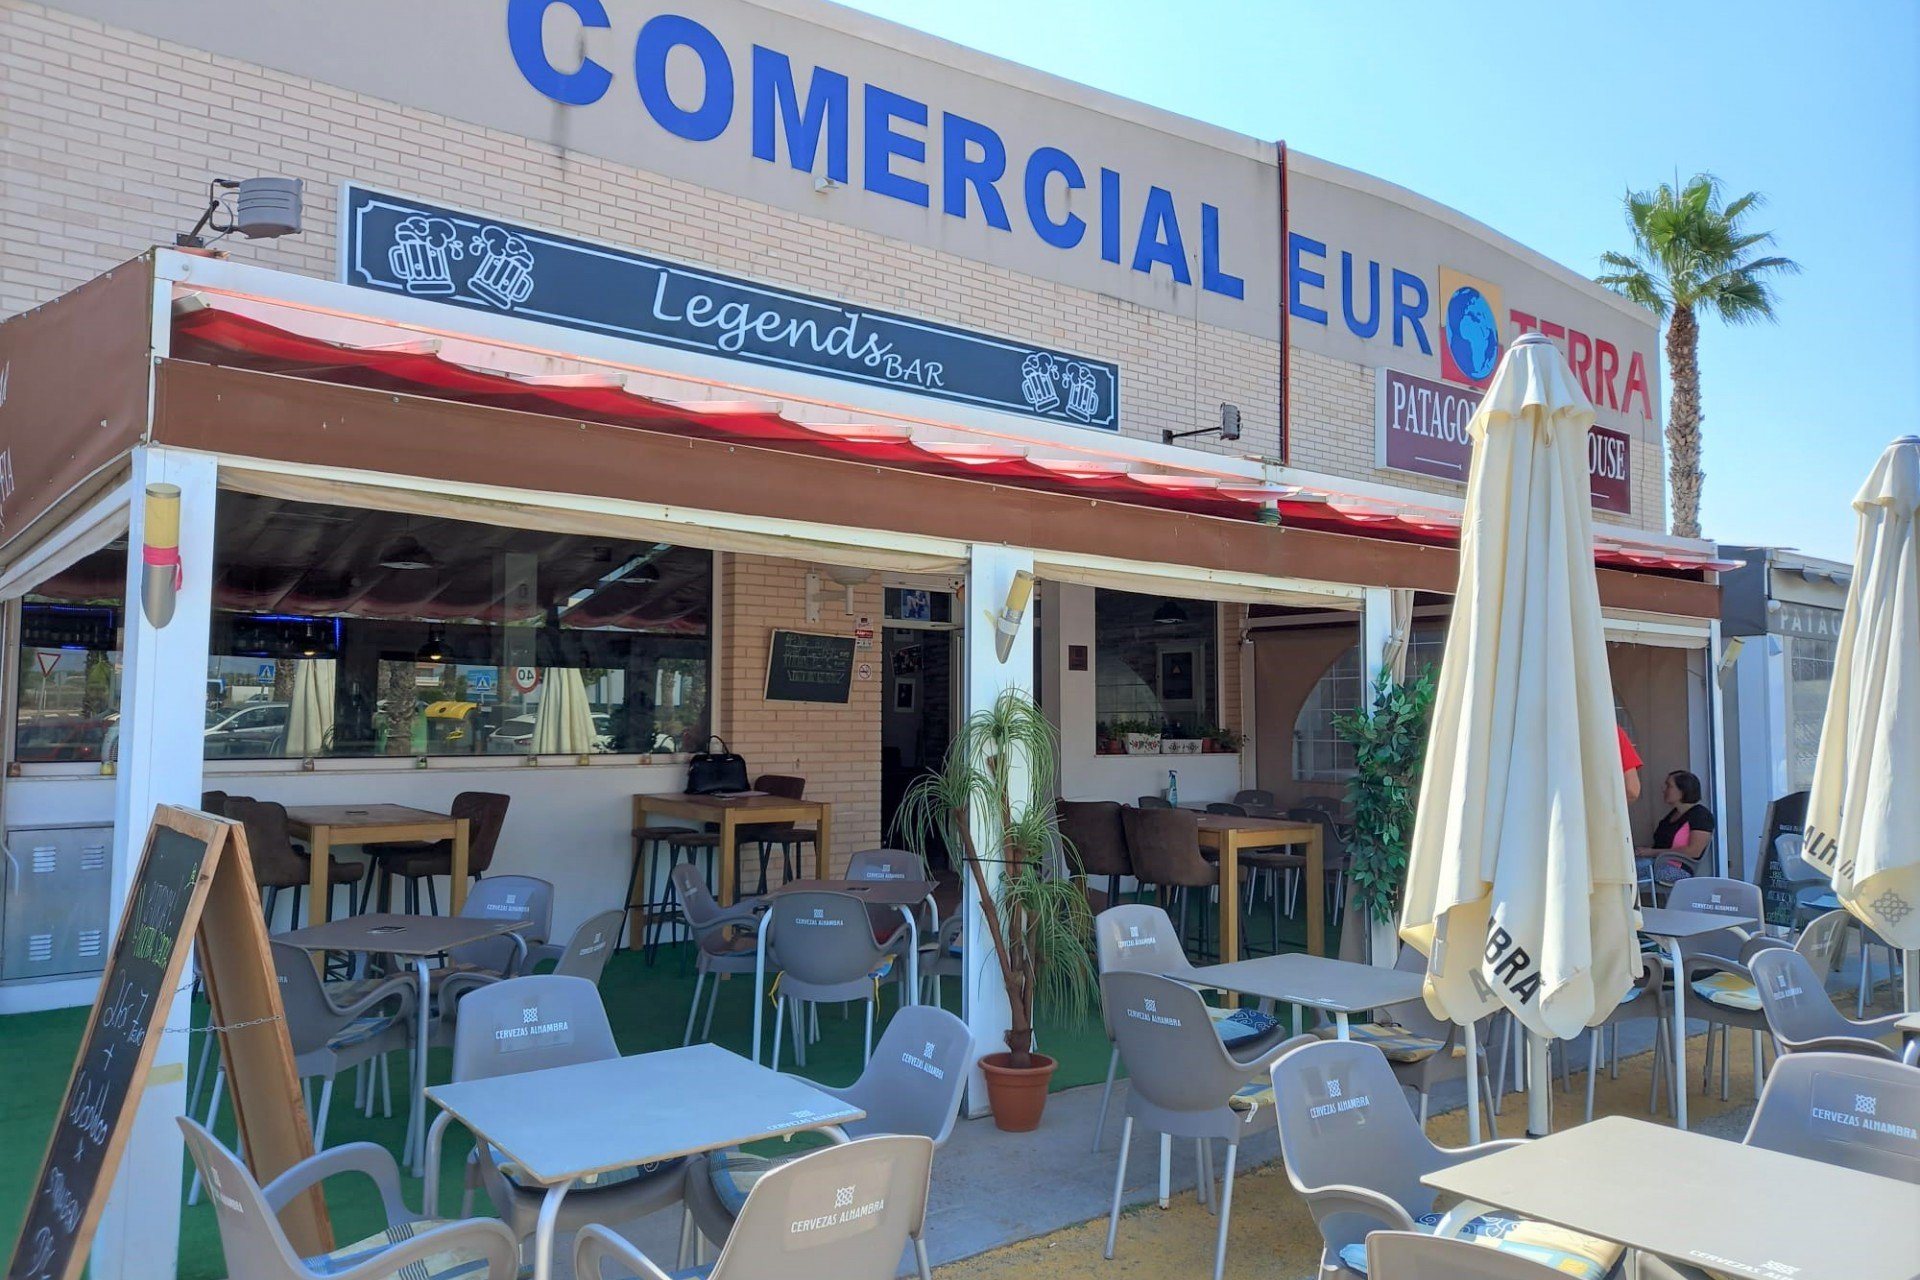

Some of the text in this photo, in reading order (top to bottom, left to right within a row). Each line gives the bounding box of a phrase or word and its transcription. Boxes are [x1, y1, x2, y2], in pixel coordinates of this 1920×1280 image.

[508, 0, 1244, 300] COMERCIAL
[1509, 308, 1652, 420] TRRA
[652, 271, 945, 387] Legends BAR
[495, 1021, 569, 1040] CERVEZAS ALHAMBRA
[1309, 1095, 1371, 1119] CERVEZAS ALHAMBRA
[1812, 1107, 1918, 1140] CERVEZAS ALHAMBRA
[790, 1199, 885, 1233] CERVEZAS ALHAMBRA
